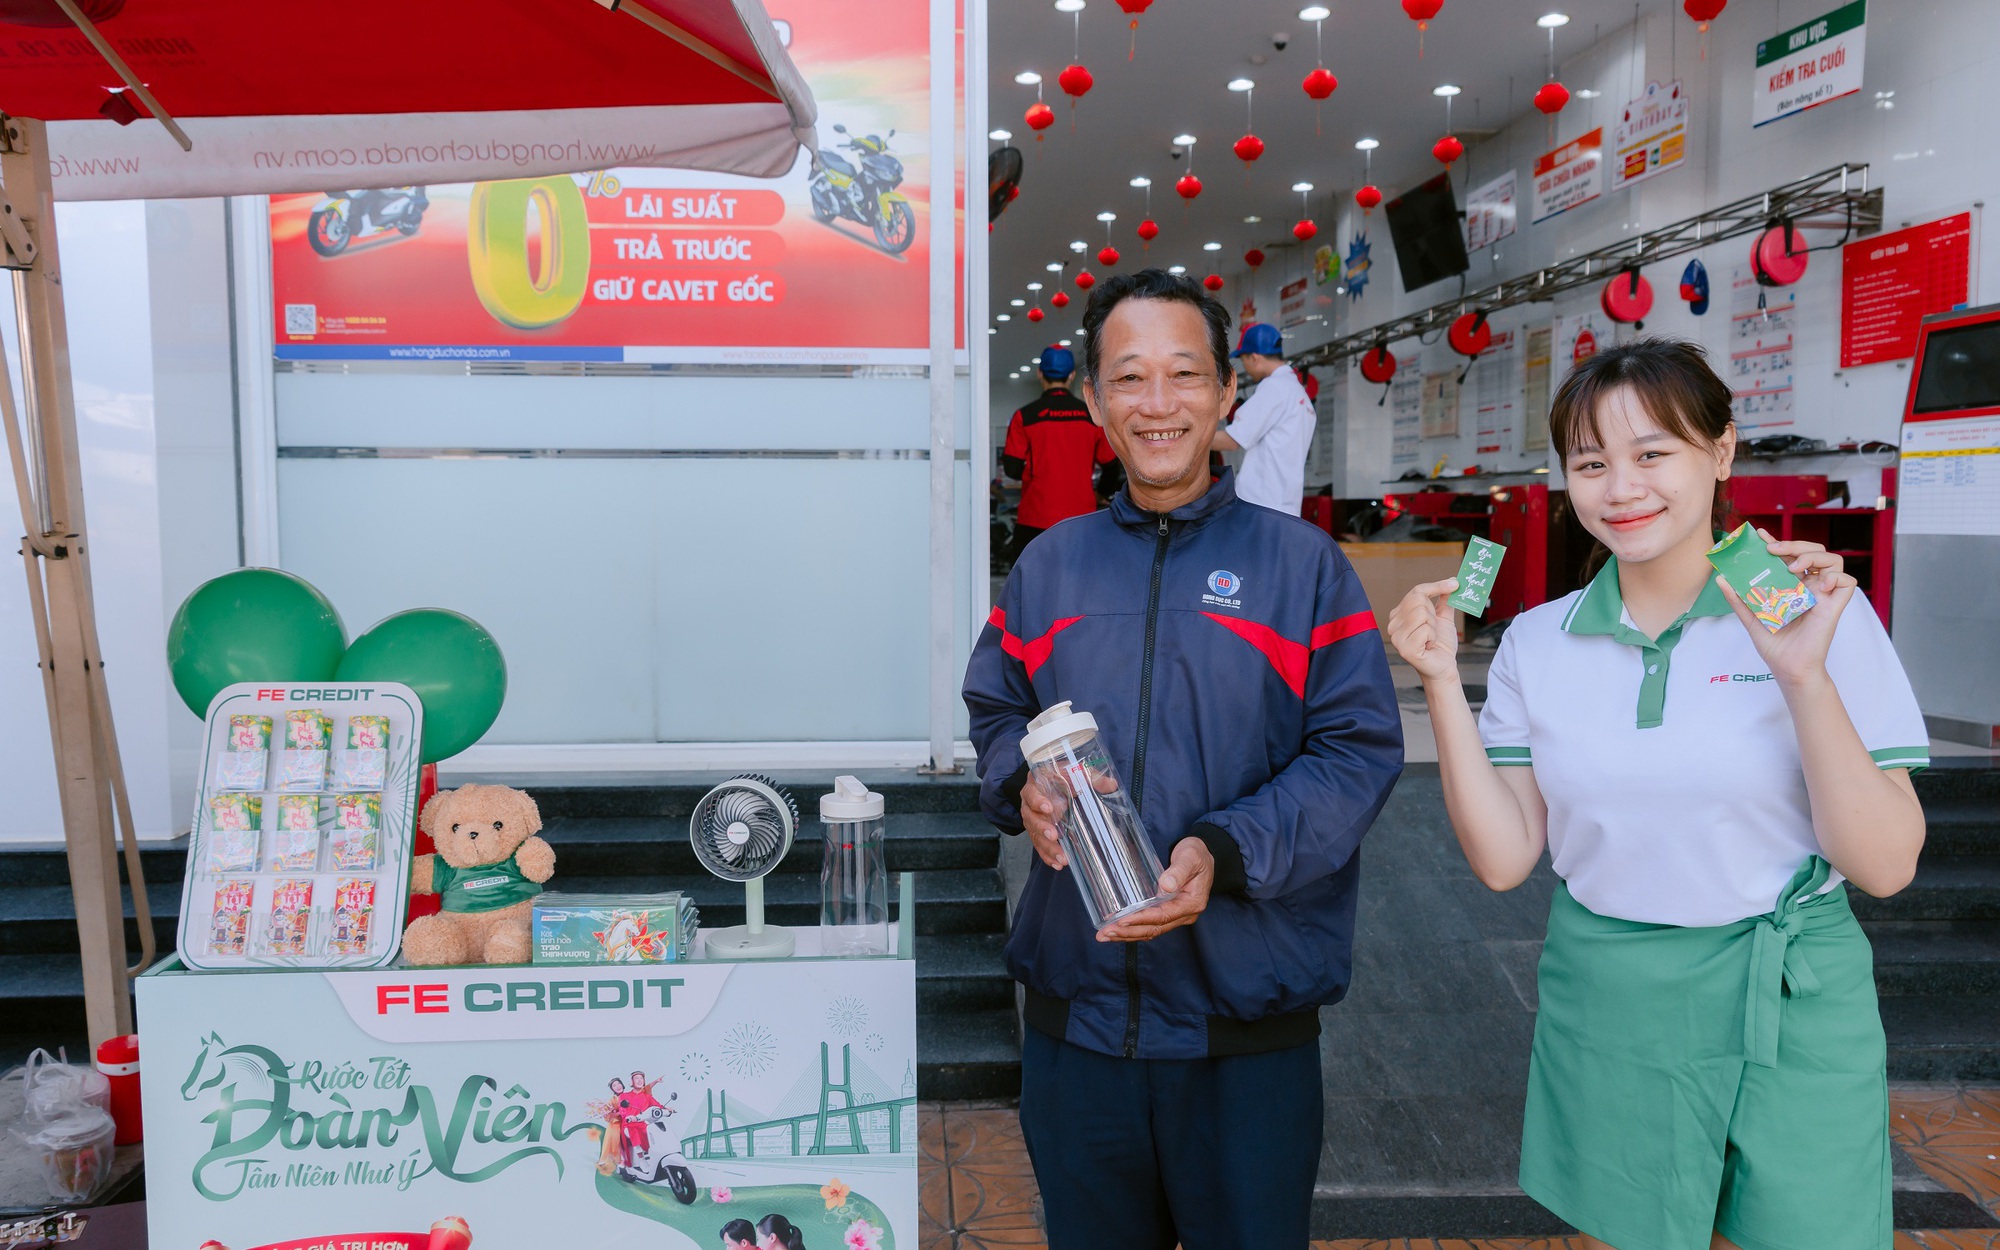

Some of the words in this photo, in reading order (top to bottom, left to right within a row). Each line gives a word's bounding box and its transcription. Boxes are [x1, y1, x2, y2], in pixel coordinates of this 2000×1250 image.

[1788, 29, 1808, 50] KHU
[1809, 20, 1828, 43] VỰC
[1769, 64, 1795, 93] KIỂM
[1798, 60, 1816, 82] TRA
[1820, 42, 1846, 74] CUỐI
[625, 193, 663, 218] LÃI
[672, 191, 737, 219] SUẤT
[613, 233, 663, 260] TRẢ
[672, 235, 751, 261] TRƯỚC
[593, 276, 635, 301] GIỮ
[642, 280, 718, 301] CAVET
[727, 275, 774, 301] GỐC
[1049, 410, 1088, 418] HONDA
[1217, 577, 1231, 588] HD
[1710, 675, 1729, 683] FE
[257, 689, 285, 701] FE
[290, 689, 375, 701] CREDIT
[1071, 762, 1084, 773] FE
[475, 876, 507, 887] CREDIT
[377, 984, 449, 1015] FE
[463, 978, 685, 1013] CREDIT
[300, 1060, 369, 1094] Rước
[369, 1056, 411, 1090] Tết
[197, 1044, 399, 1162] Đoàn
[405, 1075, 570, 1183] Viên
[224, 1158, 281, 1190] Tân
[285, 1163, 340, 1188] Niên
[344, 1160, 395, 1186] Như
[397, 1149, 421, 1192] Ý
